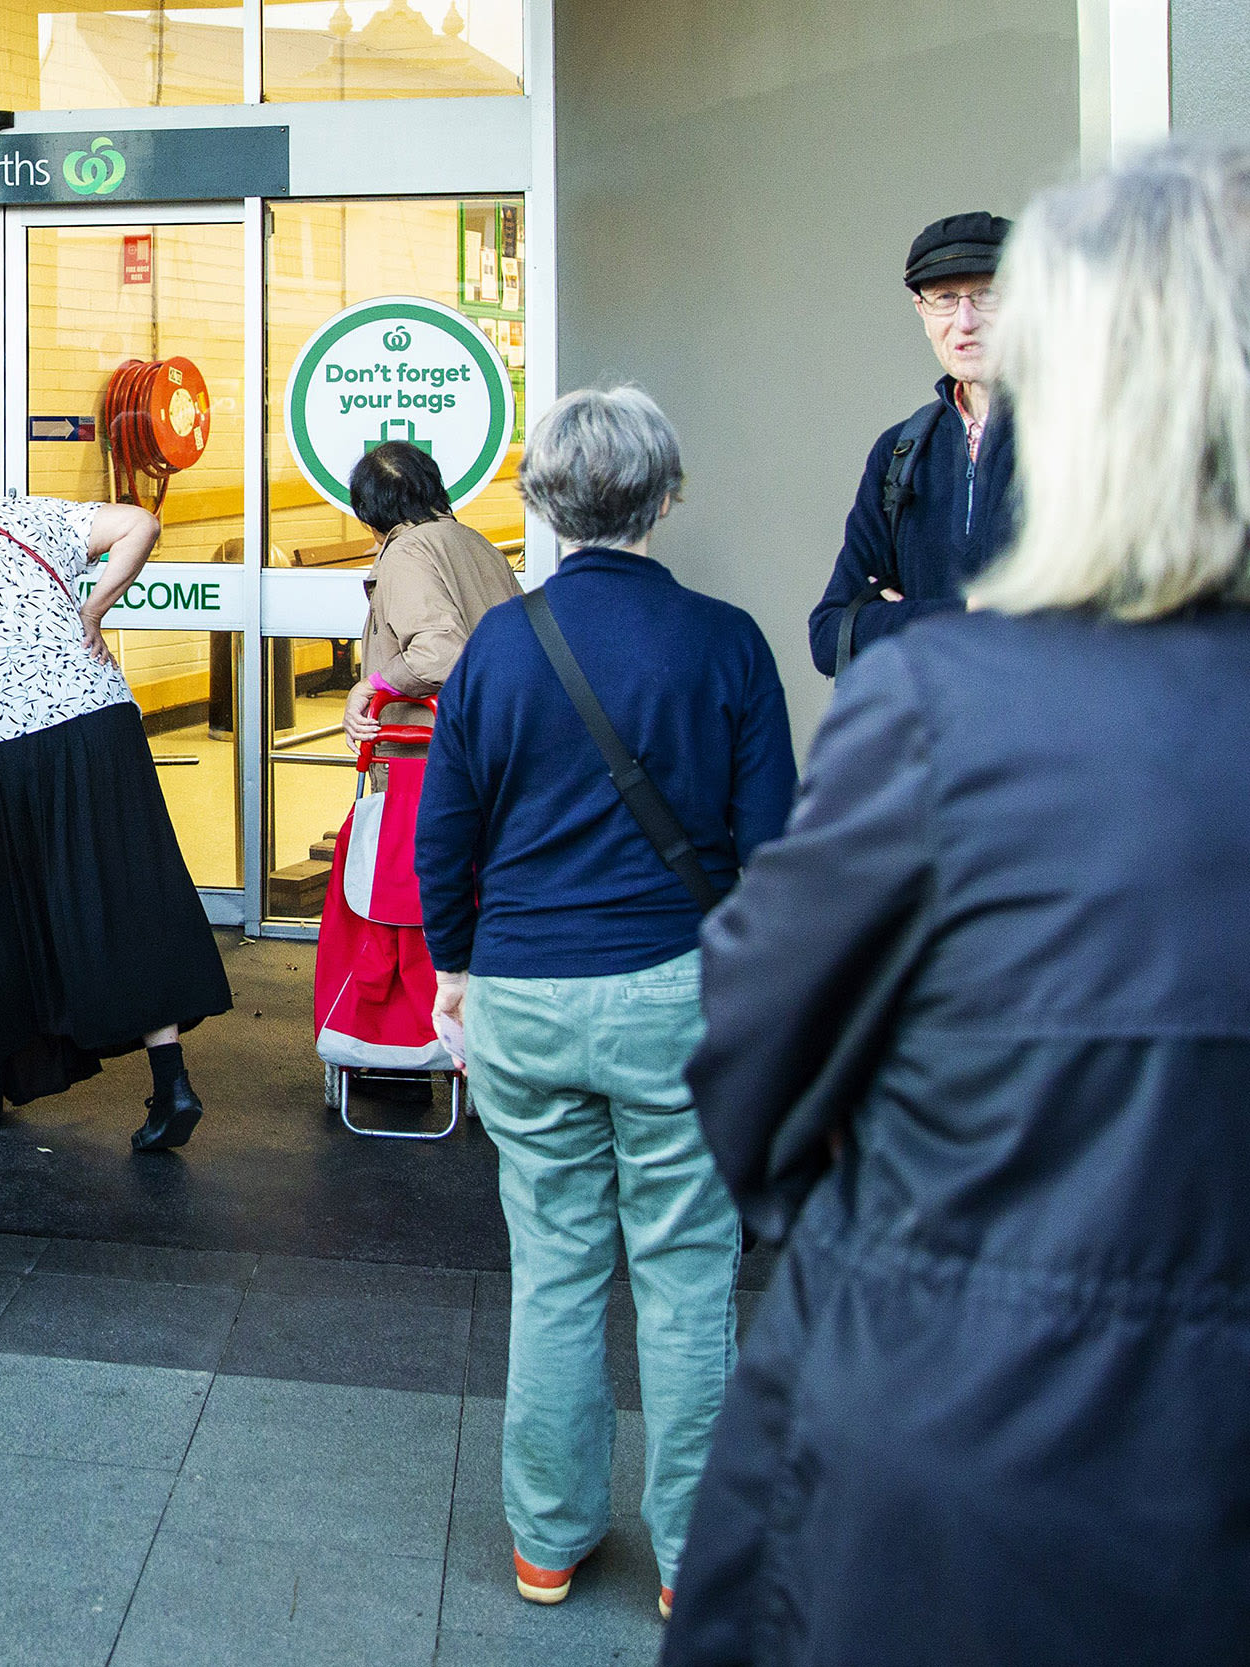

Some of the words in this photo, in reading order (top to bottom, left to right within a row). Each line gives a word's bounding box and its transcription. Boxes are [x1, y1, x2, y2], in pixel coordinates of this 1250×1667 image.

[325, 363, 392, 383] Don't
[396, 362, 471, 388] forget
[339, 394, 392, 415] your
[397, 389, 456, 414] bags
[78, 581, 221, 610] COME
